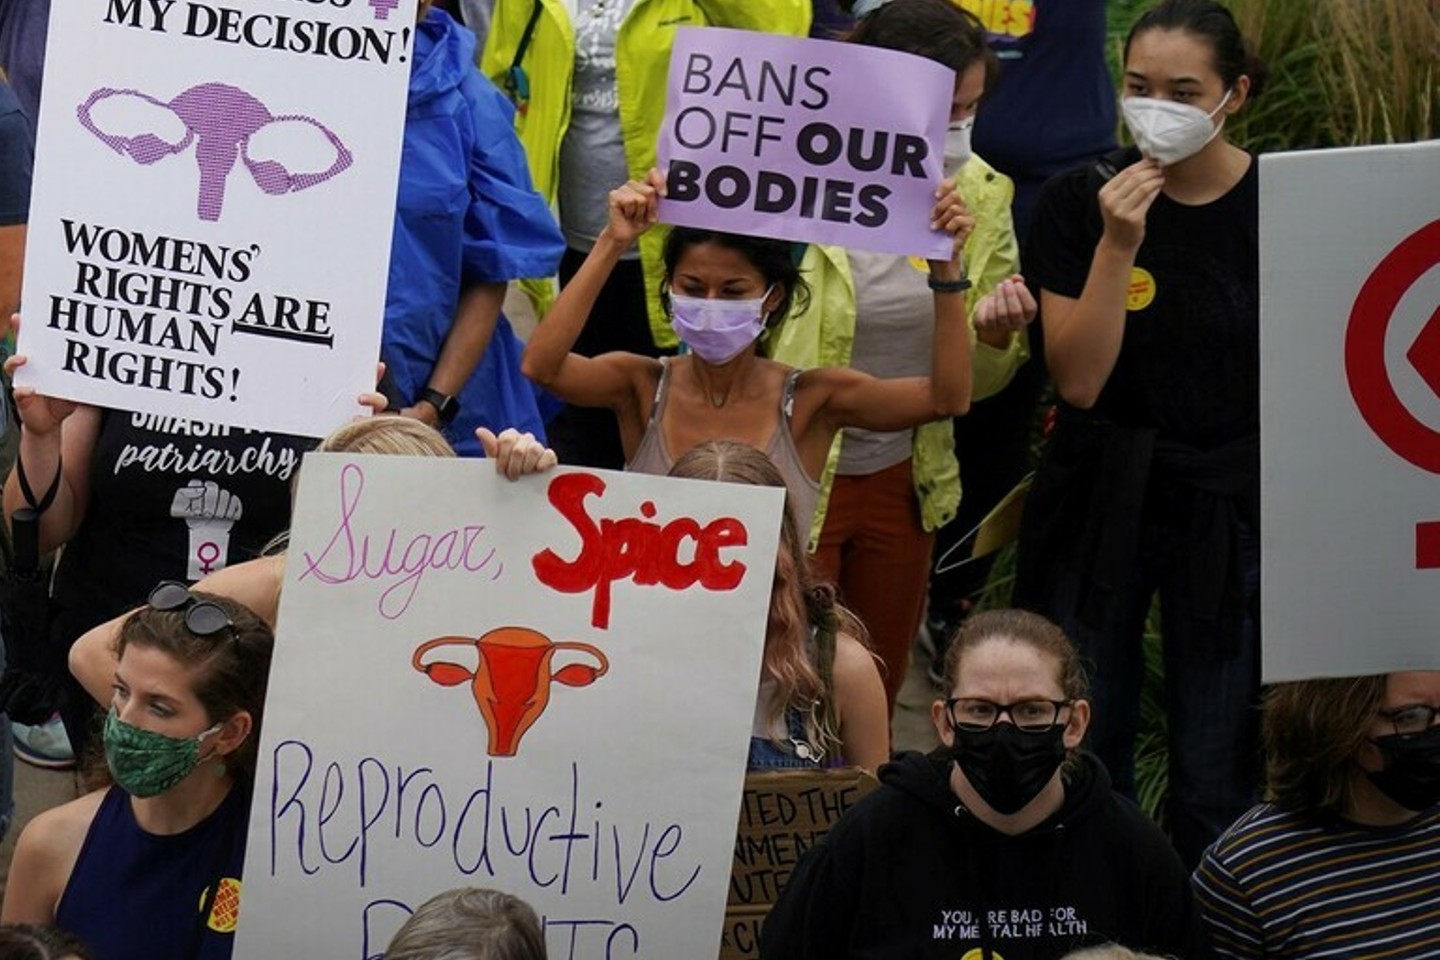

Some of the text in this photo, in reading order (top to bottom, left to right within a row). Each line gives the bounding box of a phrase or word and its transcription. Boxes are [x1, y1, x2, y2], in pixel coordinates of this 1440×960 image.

[181, 1, 412, 67] DECISION!
[681, 52, 832, 111] BANS
[674, 106, 930, 180] OFF OUR
[665, 158, 893, 228] BODIES
[46, 294, 224, 358] HUMAN
[73, 261, 333, 337] RIGHTS ARE
[61, 338, 241, 404] RIGHTS!
[113, 436, 299, 481] patriarchy
[531, 472, 749, 631] Spice
[269, 739, 702, 906] Reproductive
[933, 924, 956, 939] MY
[959, 923, 1024, 939] METAL
[1011, 909, 1043, 924] BAD
